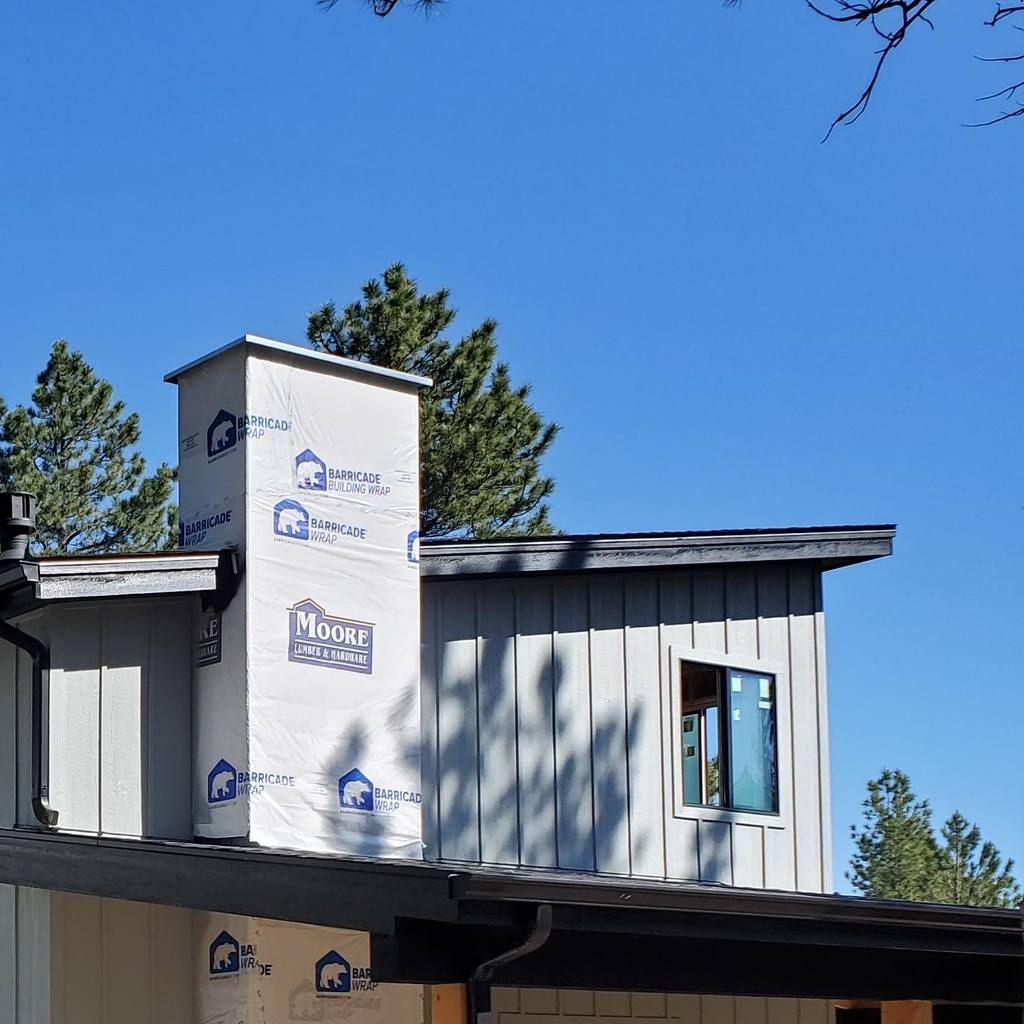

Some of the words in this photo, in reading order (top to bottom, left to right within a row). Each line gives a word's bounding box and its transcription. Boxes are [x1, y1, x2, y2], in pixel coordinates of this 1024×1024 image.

[237, 427, 265, 441] WRAP
[328, 468, 381, 485] BARRICADE
[328, 480, 366, 495] BUILDING
[368, 483, 391, 496] WRAP
[185, 510, 232, 536] BARRICADE
[310, 518, 366, 540] BARRICADE
[185, 531, 207, 547] WRAP
[310, 531, 337, 544] WRAP
[295, 611, 369, 647] MOORE
[293, 642, 322, 658] LUMBER
[322, 649, 330, 659] &
[330, 650, 368, 665] HARDWARE
[237, 771, 296, 787] BARRICADE
[237, 783, 265, 796] WRAP
[374, 800, 400, 812] WRAP
[352, 980, 378, 992] WRAP
